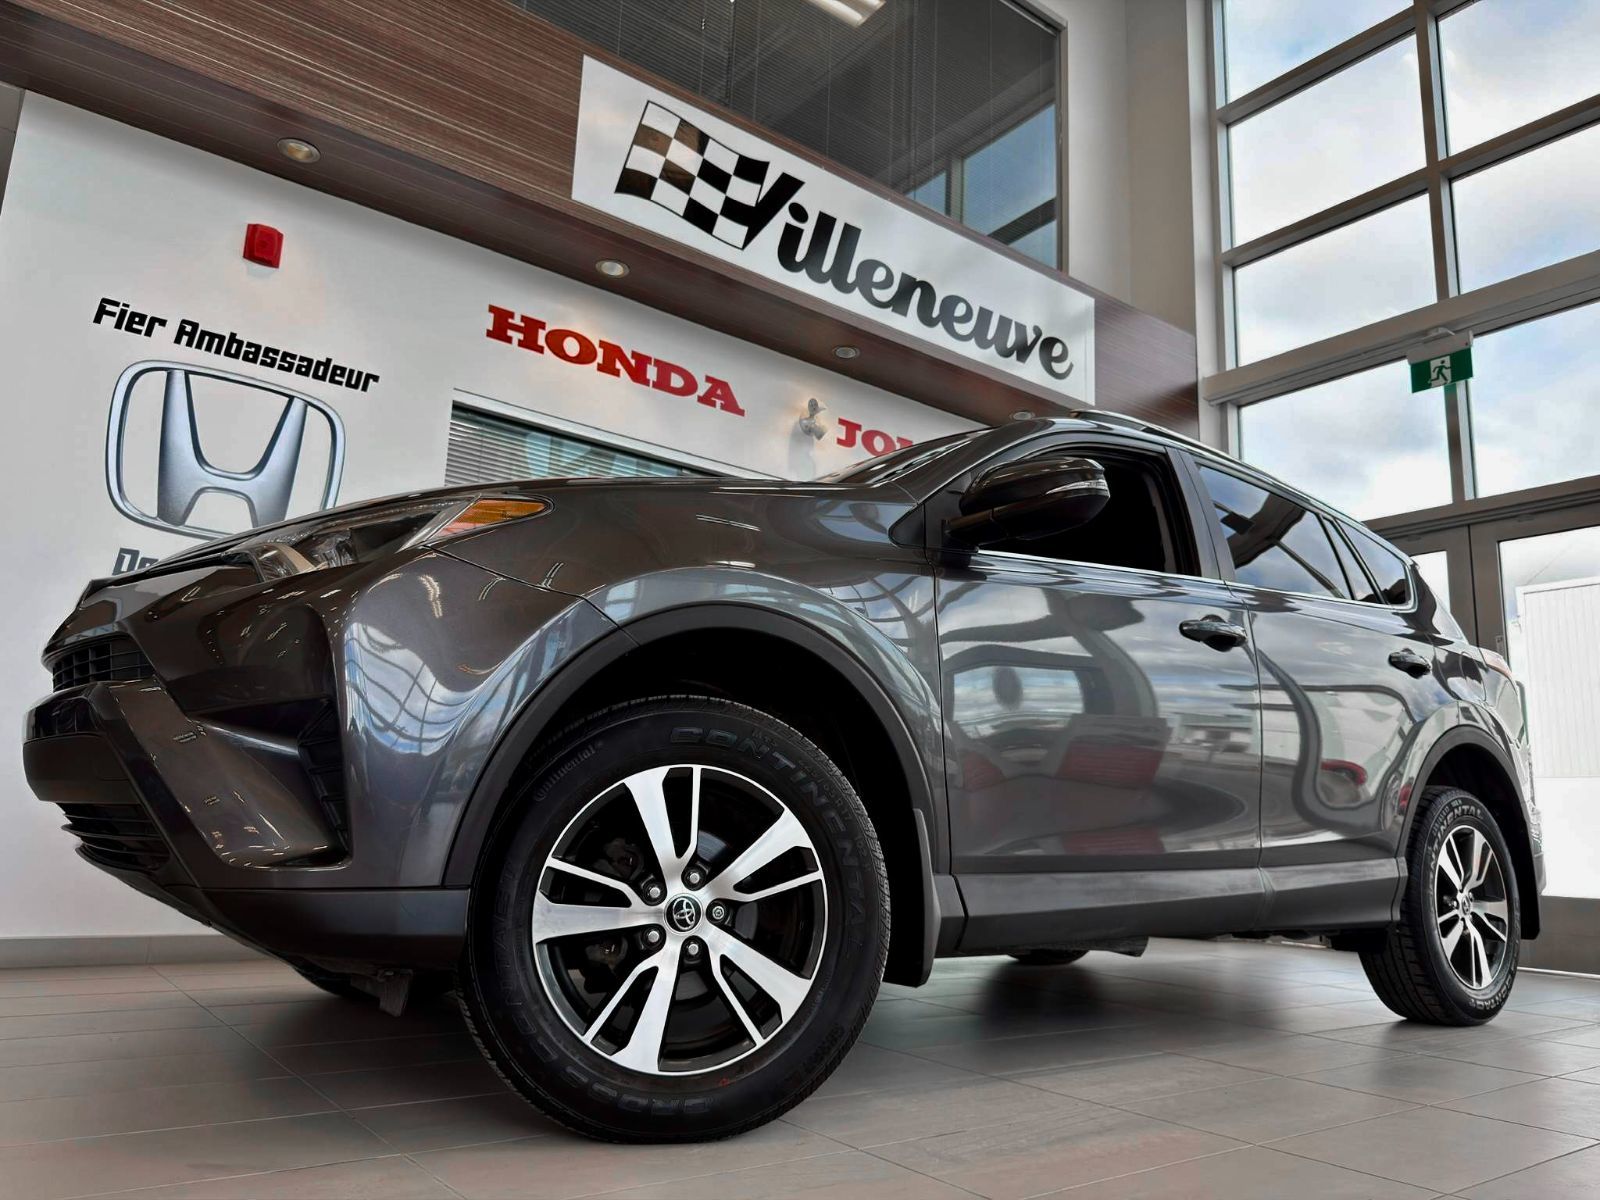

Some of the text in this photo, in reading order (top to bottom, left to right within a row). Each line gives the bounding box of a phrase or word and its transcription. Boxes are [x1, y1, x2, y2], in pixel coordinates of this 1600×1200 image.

[724, 172, 1074, 381] Villeneuve
[93, 297, 380, 393] Fier Ambassadeur
[486, 304, 745, 417] HONDA
[836, 417, 913, 457] JO
